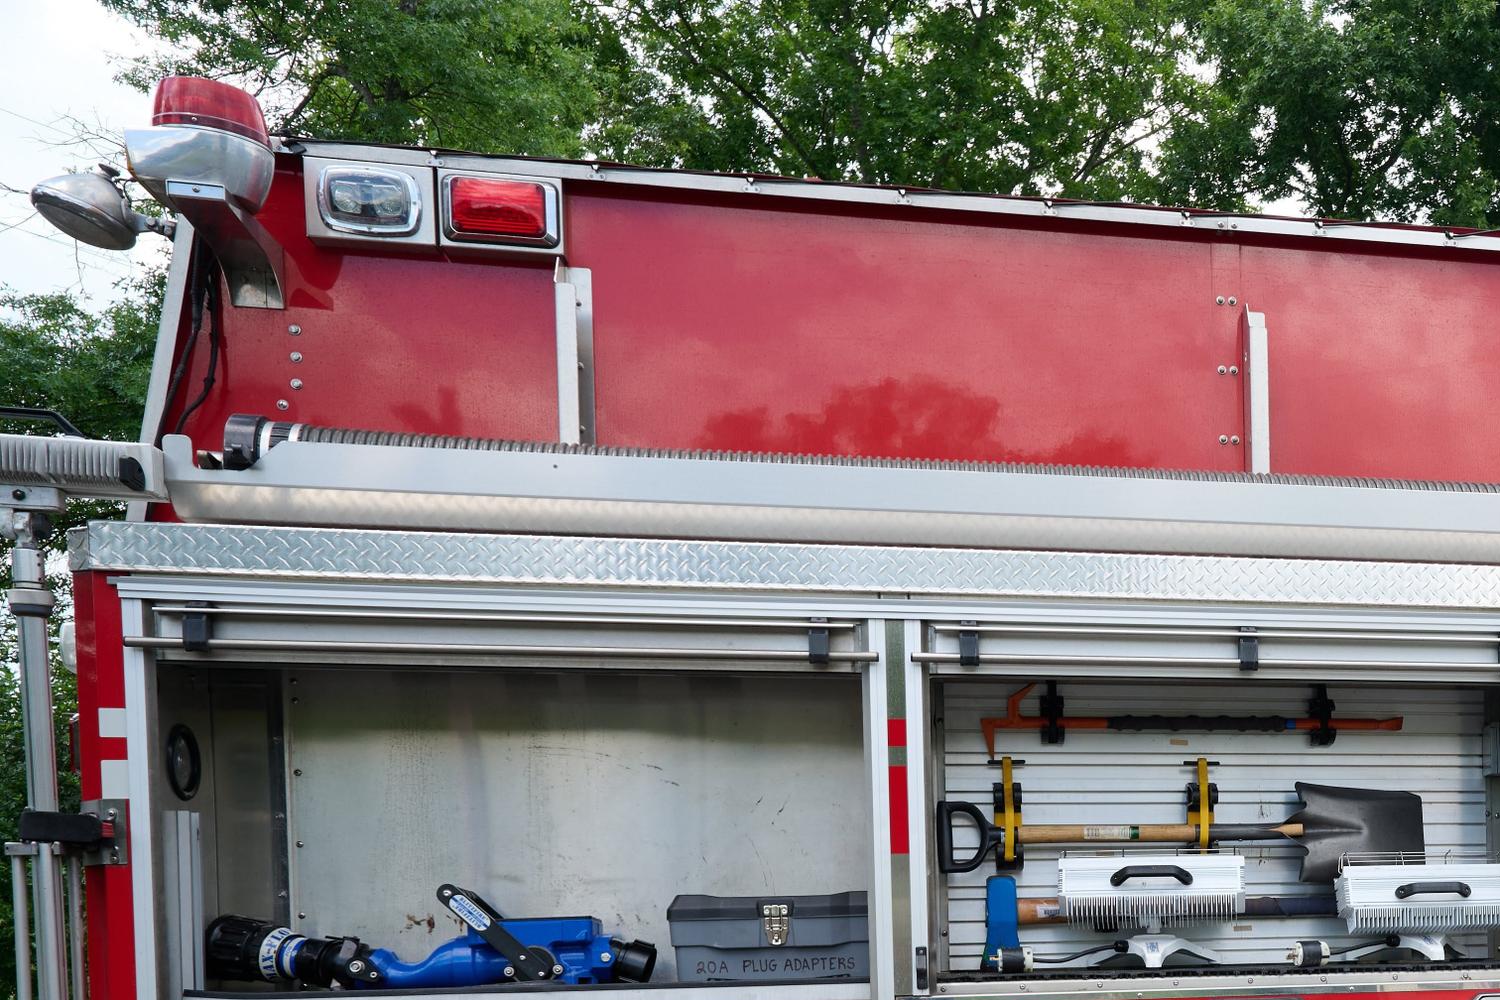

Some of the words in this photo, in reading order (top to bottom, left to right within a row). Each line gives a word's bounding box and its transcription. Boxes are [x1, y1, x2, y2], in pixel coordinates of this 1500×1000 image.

[696, 960, 729, 974] 20A
[742, 959, 778, 973] PLUG
[783, 956, 856, 972] ADAPTERS
